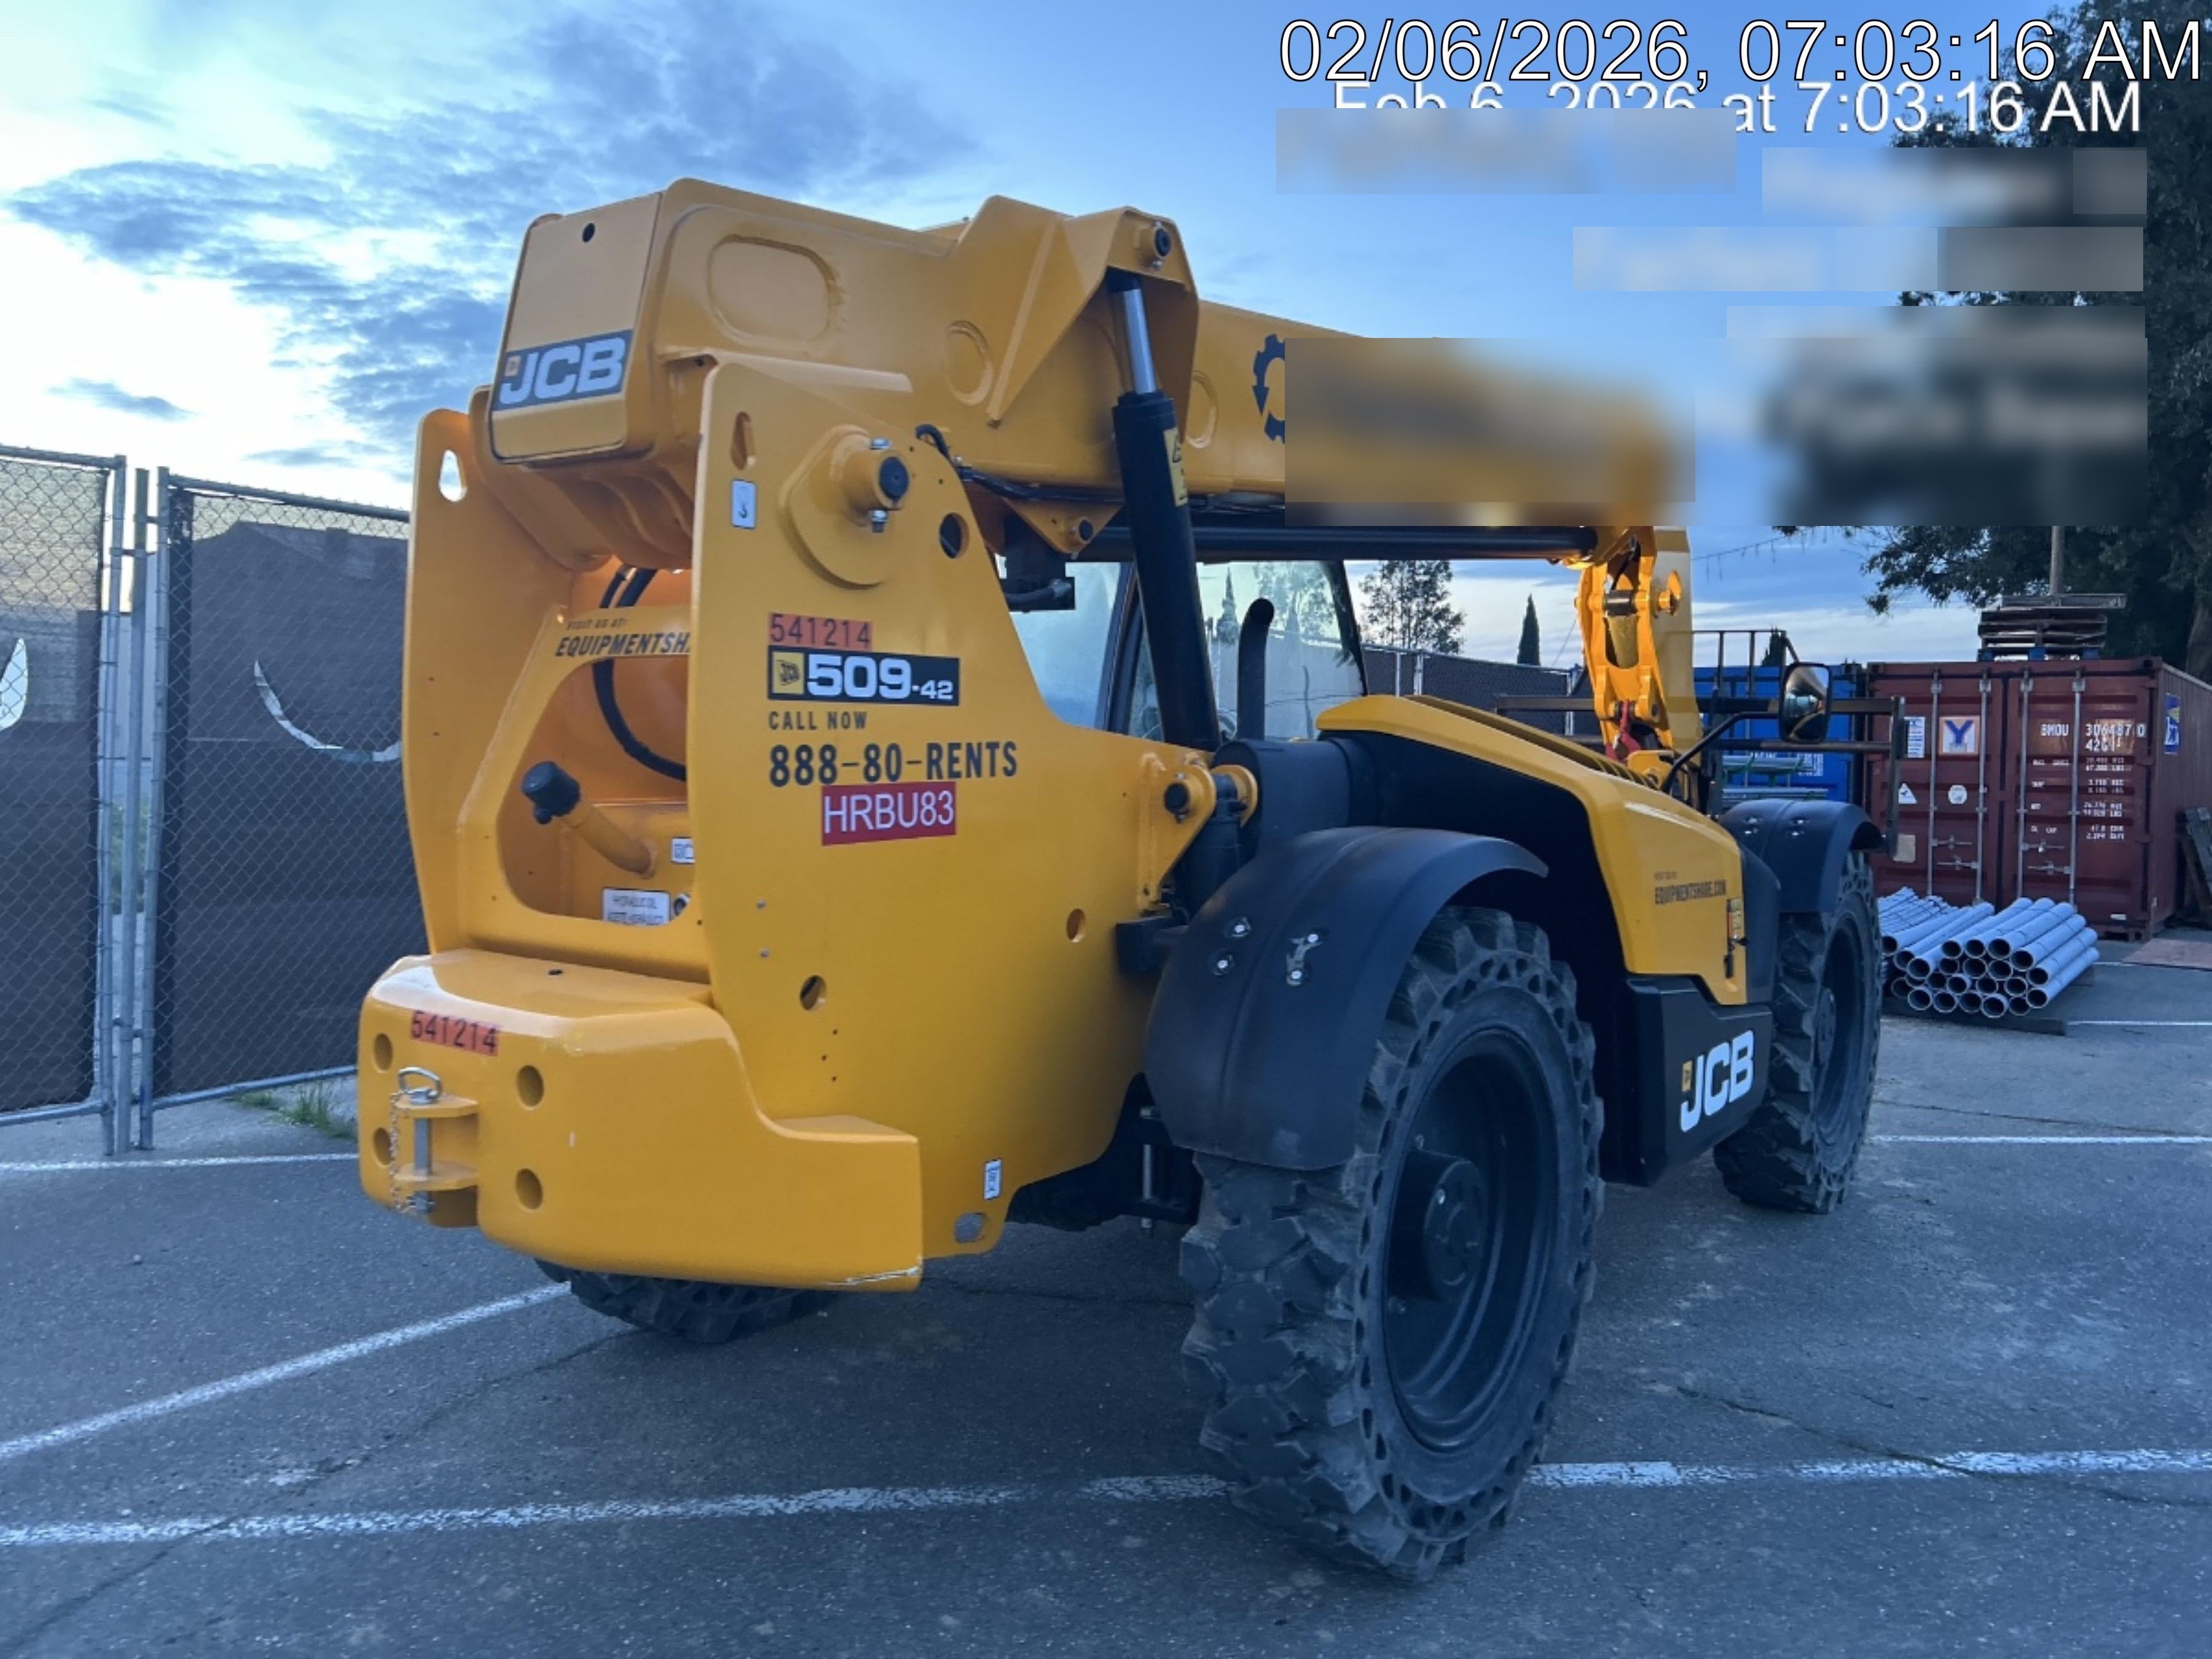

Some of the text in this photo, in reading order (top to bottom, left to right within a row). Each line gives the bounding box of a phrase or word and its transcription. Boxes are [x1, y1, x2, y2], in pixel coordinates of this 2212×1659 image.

[498, 337, 626, 405] JCB
[555, 631, 691, 657] EQUIPMENTSH
[769, 613, 871, 648] 541214
[769, 711, 867, 731] CALL NOW
[769, 740, 1018, 788] 888-80-RENTS
[823, 790, 954, 834] HRBU83
[412, 1010, 496, 1054] 541214
[1681, 1030, 1754, 1132] JCB
